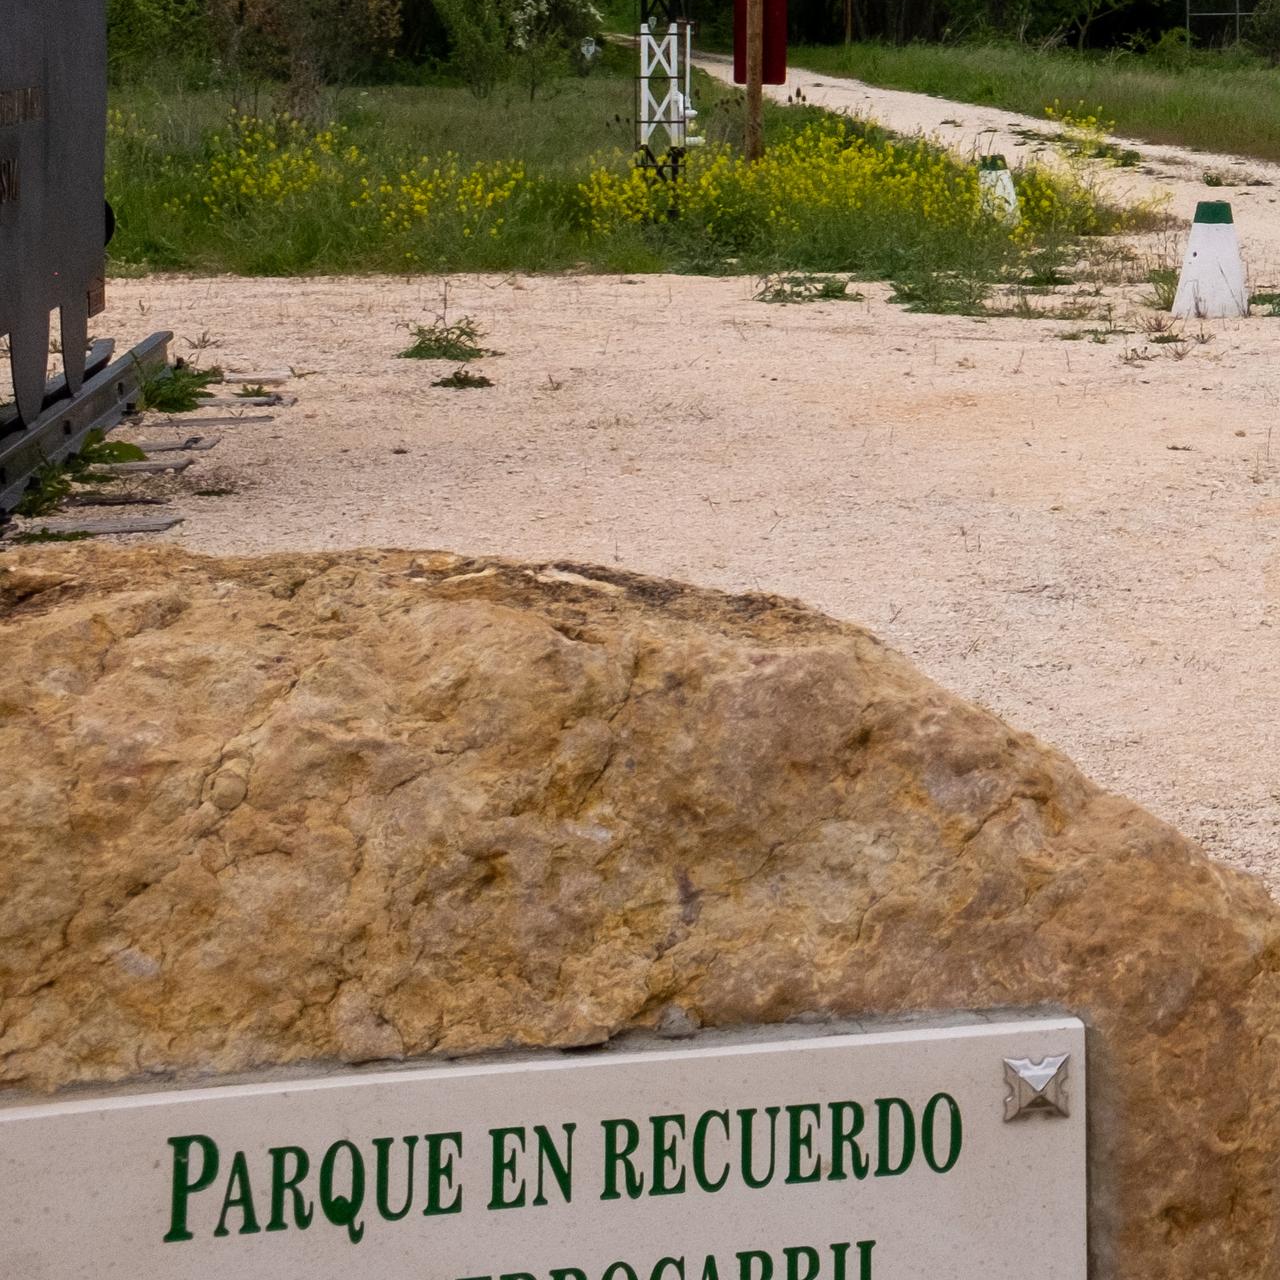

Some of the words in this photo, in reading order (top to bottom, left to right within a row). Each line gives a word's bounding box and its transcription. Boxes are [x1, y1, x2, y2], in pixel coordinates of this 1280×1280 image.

[162, 1131, 463, 1245] PARQUE
[486, 1122, 577, 1211] EN
[599, 1092, 963, 1201] RECUERDO
